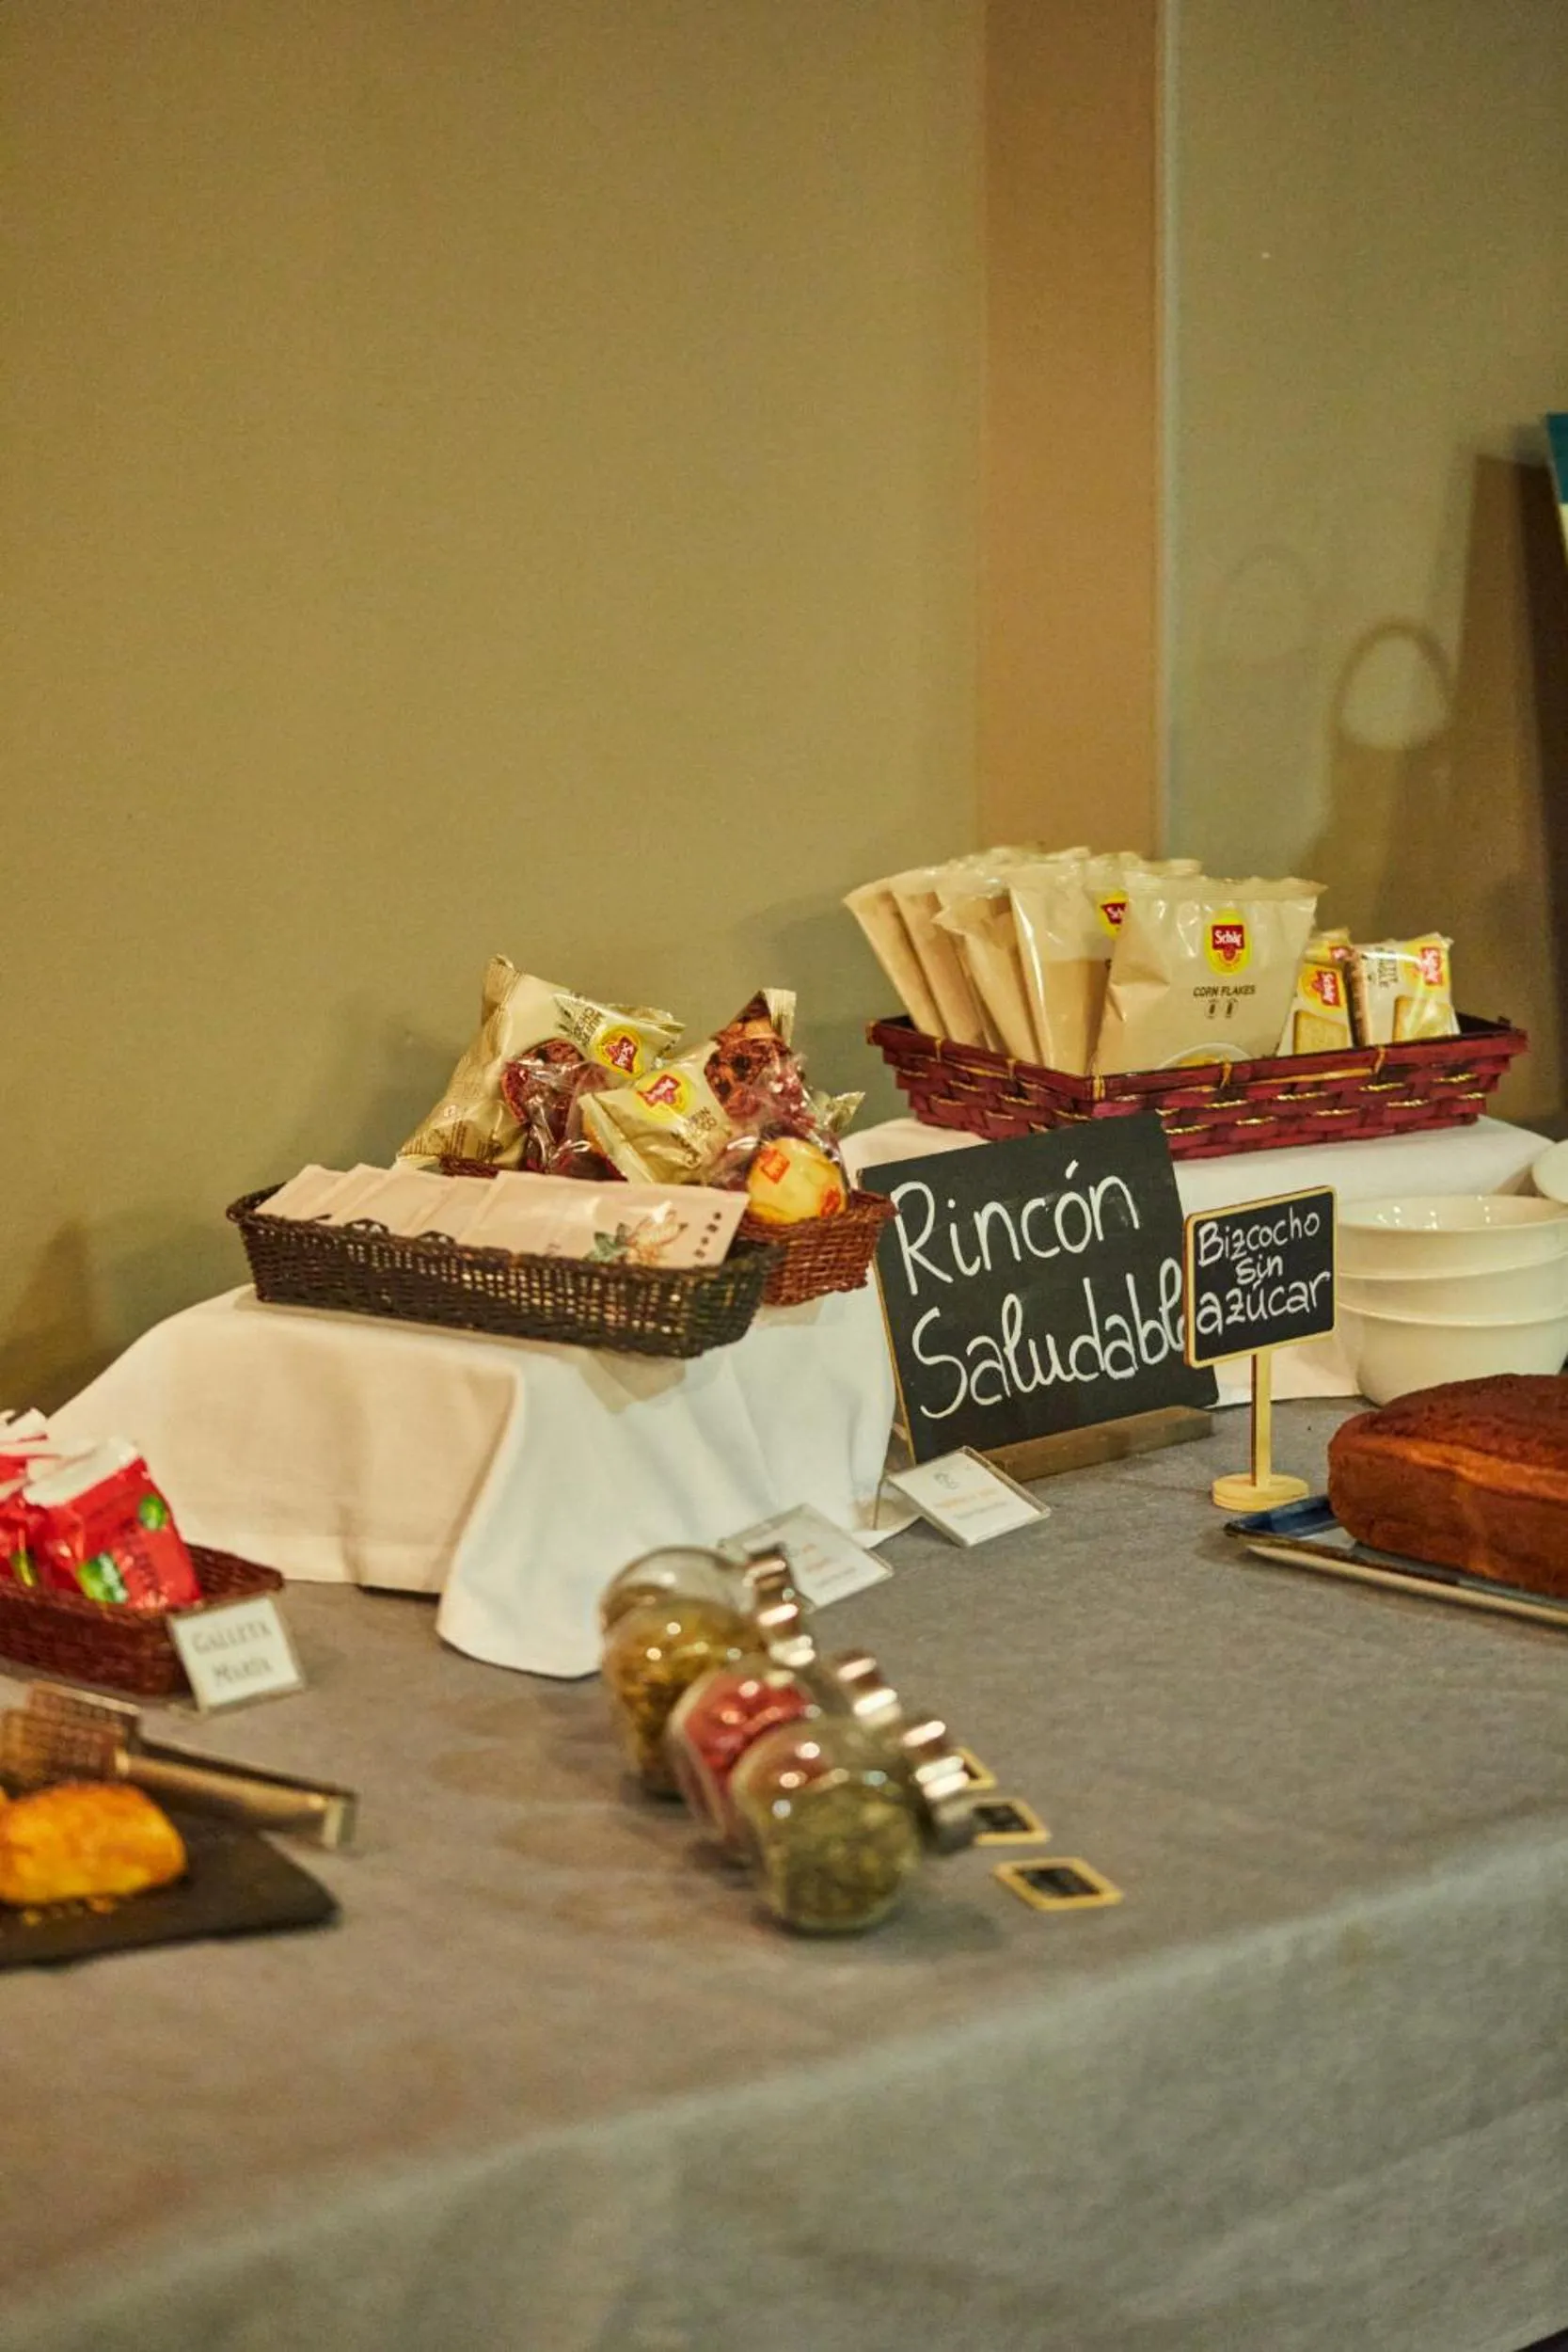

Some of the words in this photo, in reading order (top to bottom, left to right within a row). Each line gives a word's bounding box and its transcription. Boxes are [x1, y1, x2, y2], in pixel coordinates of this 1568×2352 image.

[1193, 985, 1219, 997] CORN
[1221, 984, 1257, 997] FLAKES
[890, 1160, 1141, 1295] Rincón
[1197, 1206, 1321, 1267] Bizcocho
[1235, 1253, 1283, 1285] sin
[1196, 1270, 1332, 1337] azúcar
